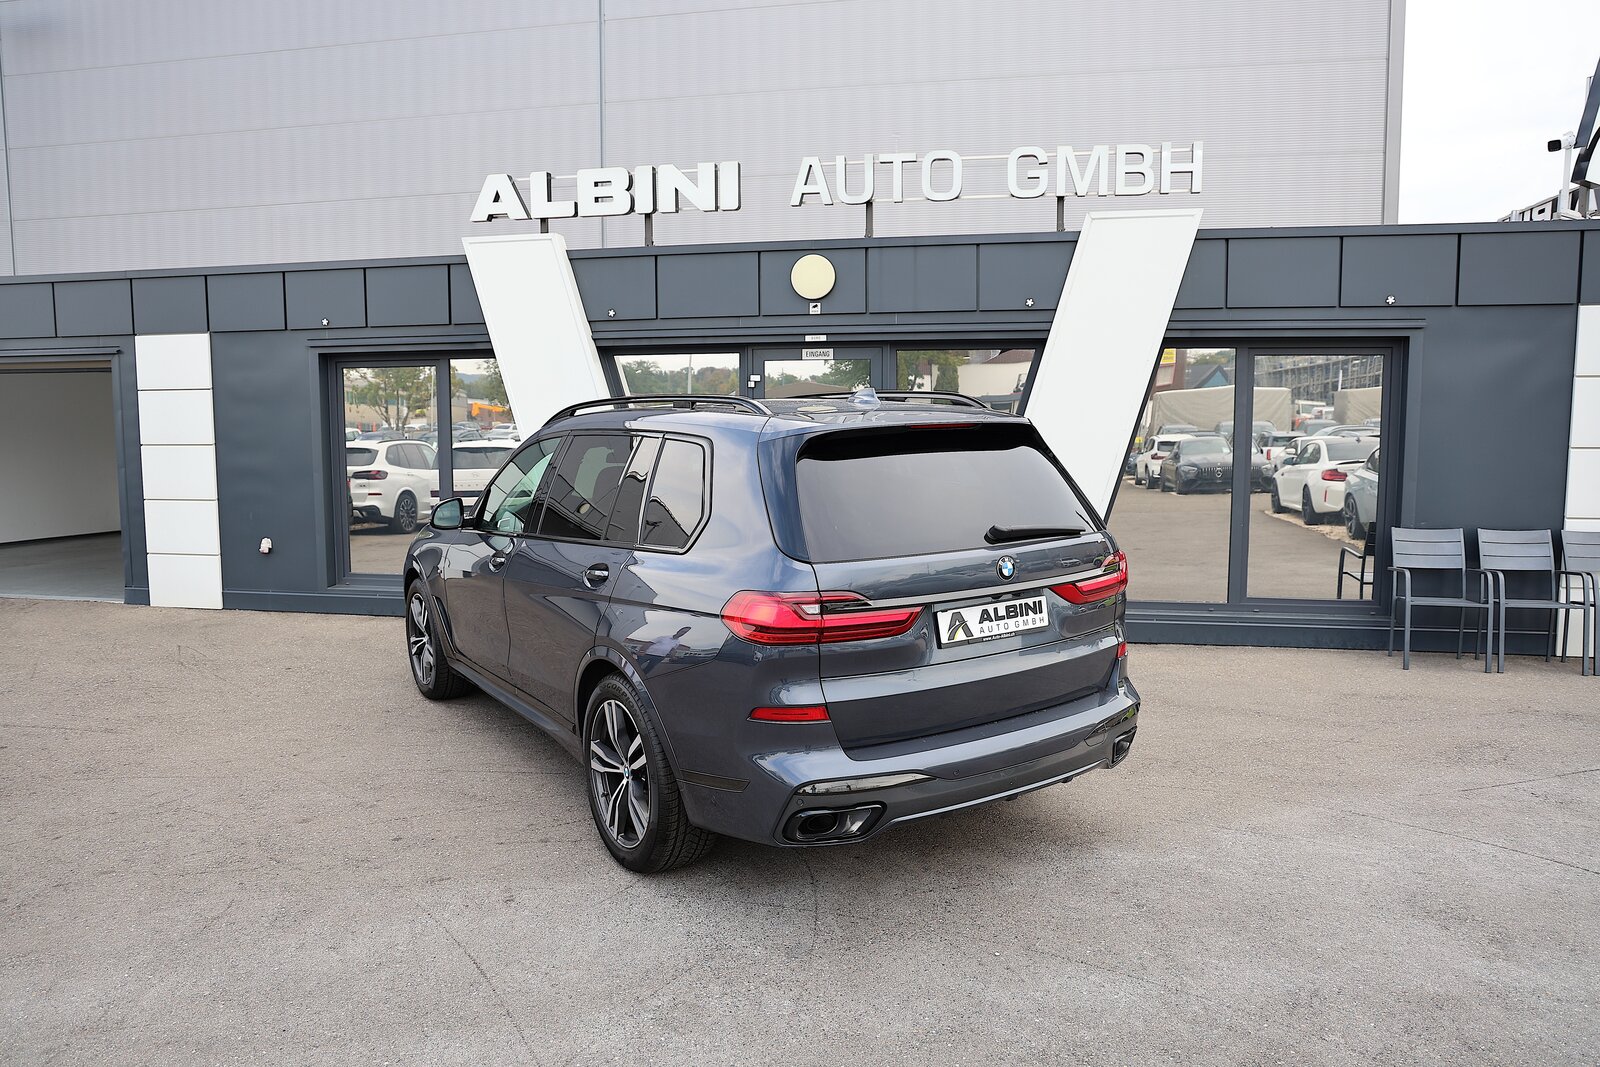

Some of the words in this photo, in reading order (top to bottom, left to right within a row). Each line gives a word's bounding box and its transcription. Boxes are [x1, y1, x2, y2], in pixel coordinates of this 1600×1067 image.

[470, 161, 741, 222] ALBINI
[790, 149, 963, 207] AUTO
[1006, 141, 1204, 199] GMBH
[805, 350, 830, 358] EINGANG
[978, 600, 1043, 624] ALBINI
[979, 622, 1009, 634] AUTO
[1014, 616, 1045, 629] GMBH
